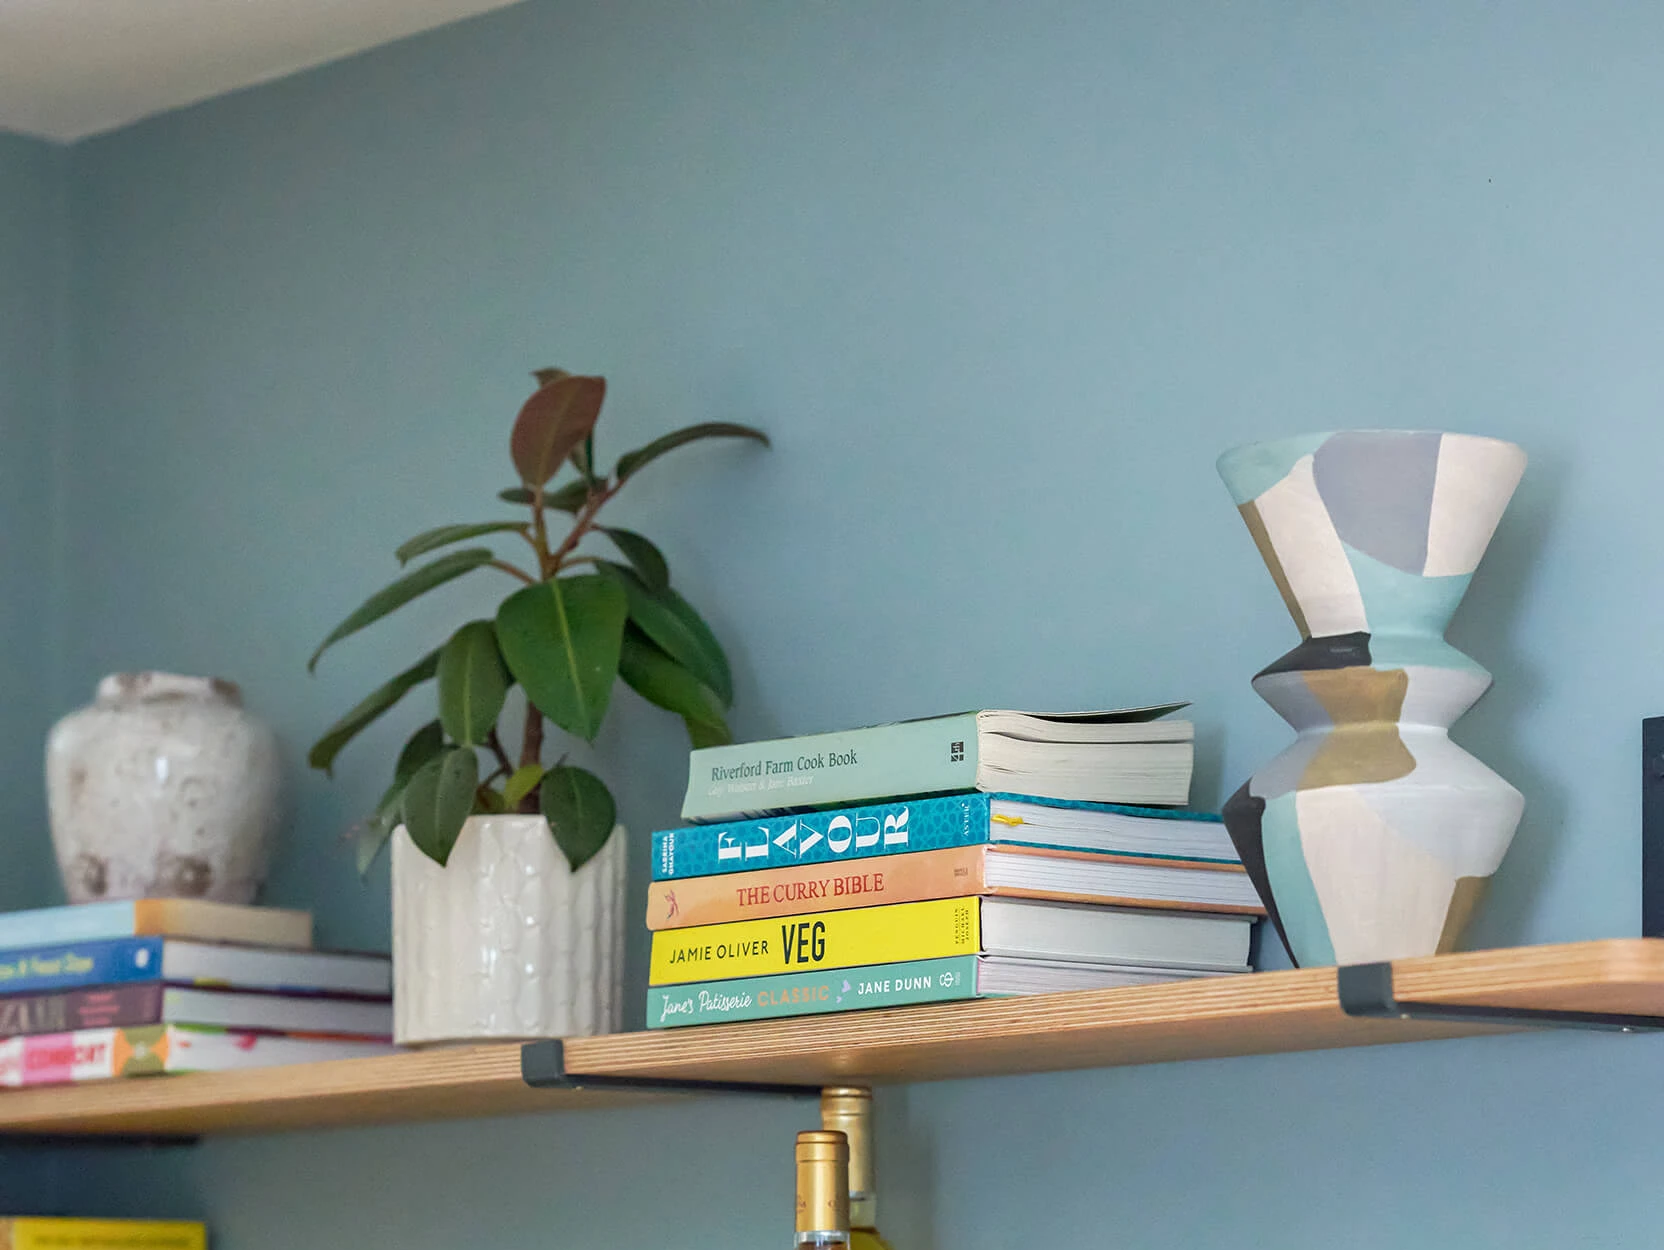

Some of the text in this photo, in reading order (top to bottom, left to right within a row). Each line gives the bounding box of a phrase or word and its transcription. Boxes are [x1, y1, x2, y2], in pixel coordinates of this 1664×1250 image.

[711, 749, 858, 781] Riverford Farm Cook Book
[718, 806, 909, 864] FLAVOUR
[736, 873, 885, 907] THE CURRY BIBLE
[669, 921, 826, 965] JAMIE OLIVER VEG
[660, 994, 694, 1023] Jane's
[697, 990, 753, 1011] Patisserie
[757, 985, 830, 1008] CLASSIC
[857, 980, 891, 995] JANE
[895, 976, 932, 991] DUNN
